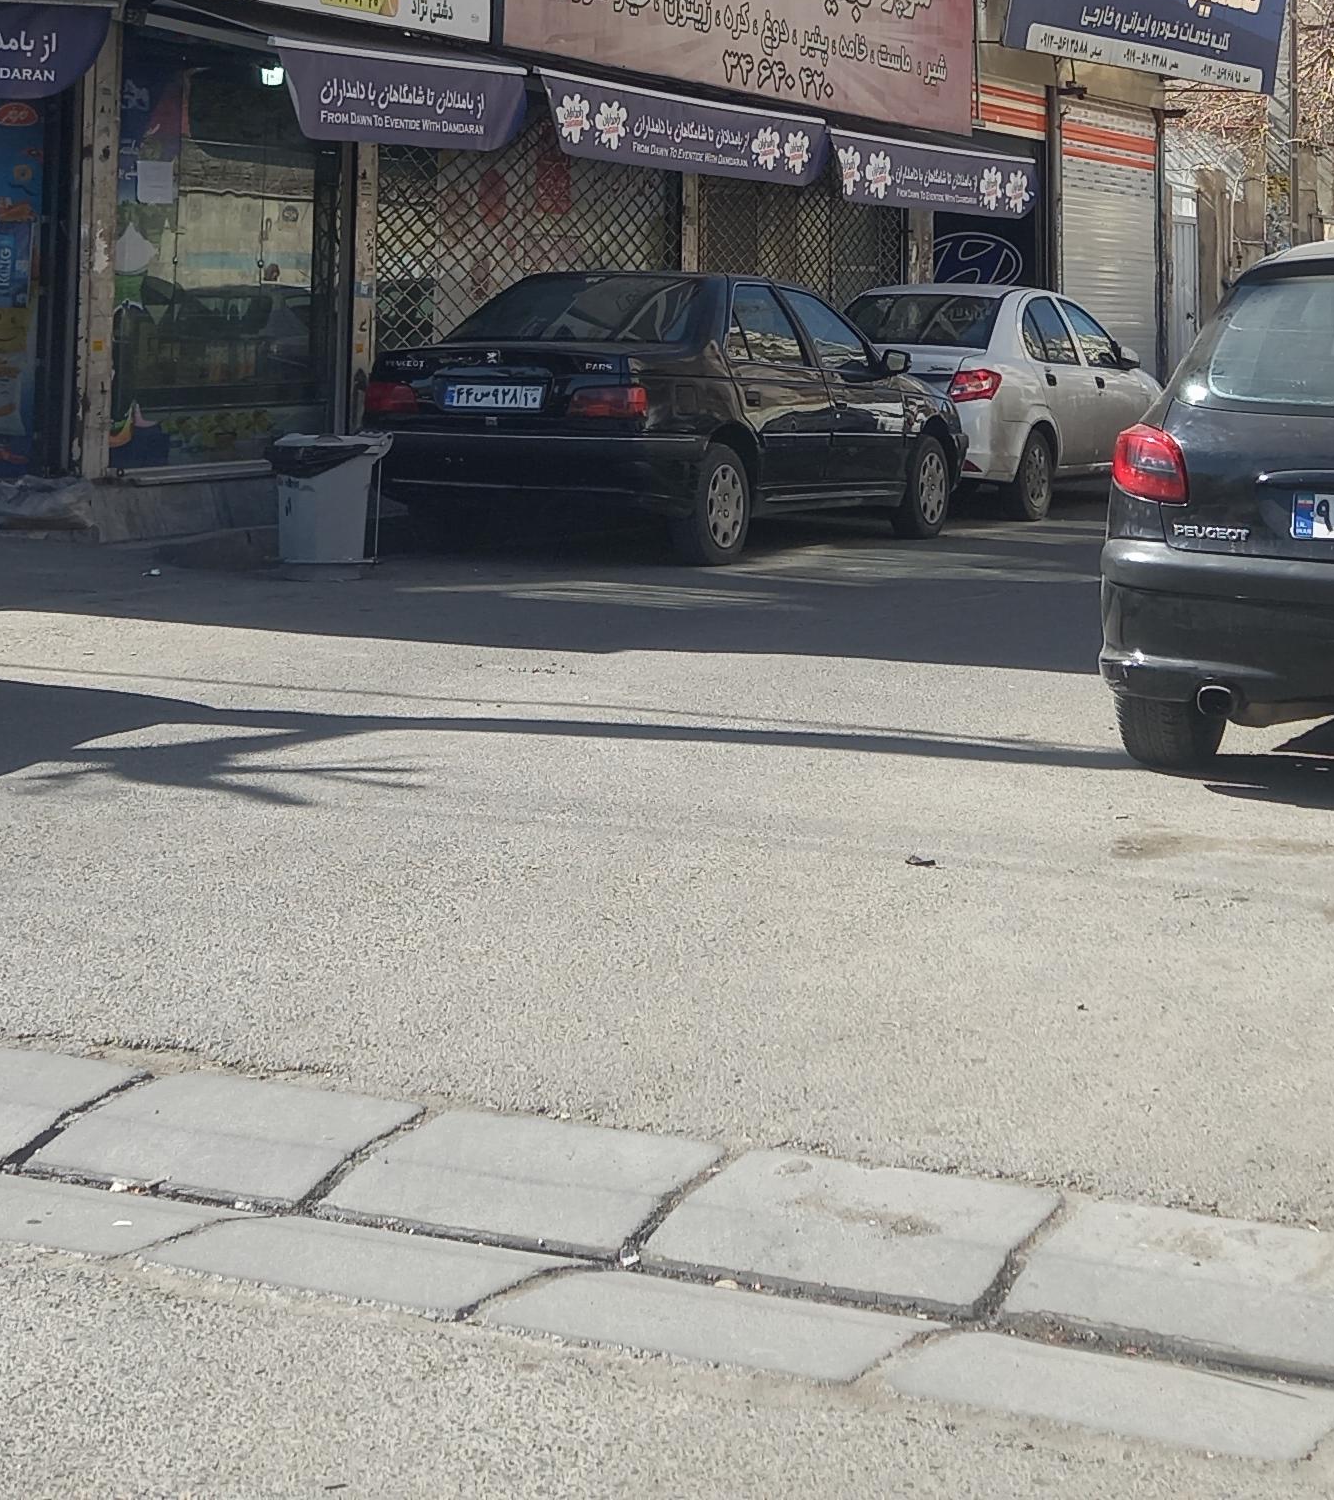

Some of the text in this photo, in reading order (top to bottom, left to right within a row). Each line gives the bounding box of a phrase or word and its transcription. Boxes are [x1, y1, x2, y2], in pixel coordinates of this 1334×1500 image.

[430, 0, 454, 24] دشتی
[724, 2, 750, 39] کره
[1080, 4, 1115, 28] خارجی
[40, 31, 57, 62] از
[761, 10, 789, 56] دوغ
[800, 25, 829, 67] پنیر
[839, 33, 868, 61] خامه
[1178, 22, 1212, 48] خدمات
[878, 45, 911, 72] ماست
[924, 54, 947, 86] شیر
[320, 77, 485, 119] از بامدادان تا شامگاهان با دامداران
[320, 110, 485, 135] FROM DAWN TO EVENTIDE WITH DAMDARAN
[1173, 524, 1251, 542] PEUGEOT
